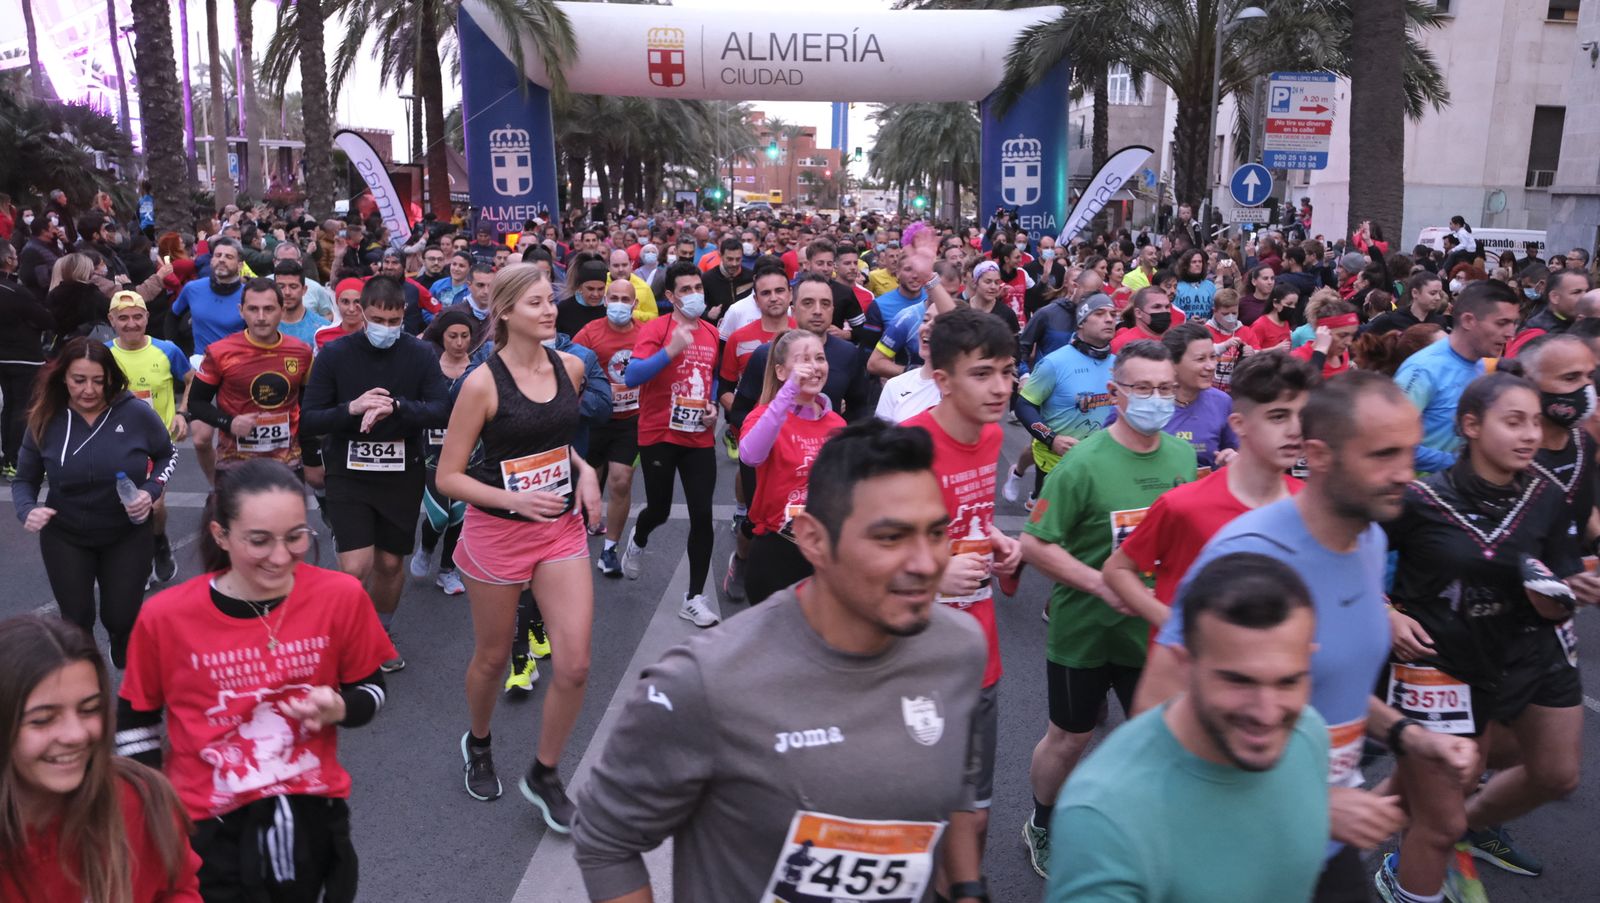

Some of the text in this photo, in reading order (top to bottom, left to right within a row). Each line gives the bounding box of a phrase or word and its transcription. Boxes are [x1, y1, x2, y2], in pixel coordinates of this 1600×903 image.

[720, 27, 884, 62] ALMERÍA
[720, 67, 803, 86] CIUDAD
[1273, 87, 1289, 106] P
[496, 221, 525, 232] CIUD
[1194, 295, 1200, 303] A
[250, 425, 282, 439] 428
[360, 443, 396, 457] 364
[520, 465, 562, 490] 3474
[202, 647, 261, 667] CARRERA
[1405, 689, 1458, 708] 3570
[810, 854, 907, 895] 455
